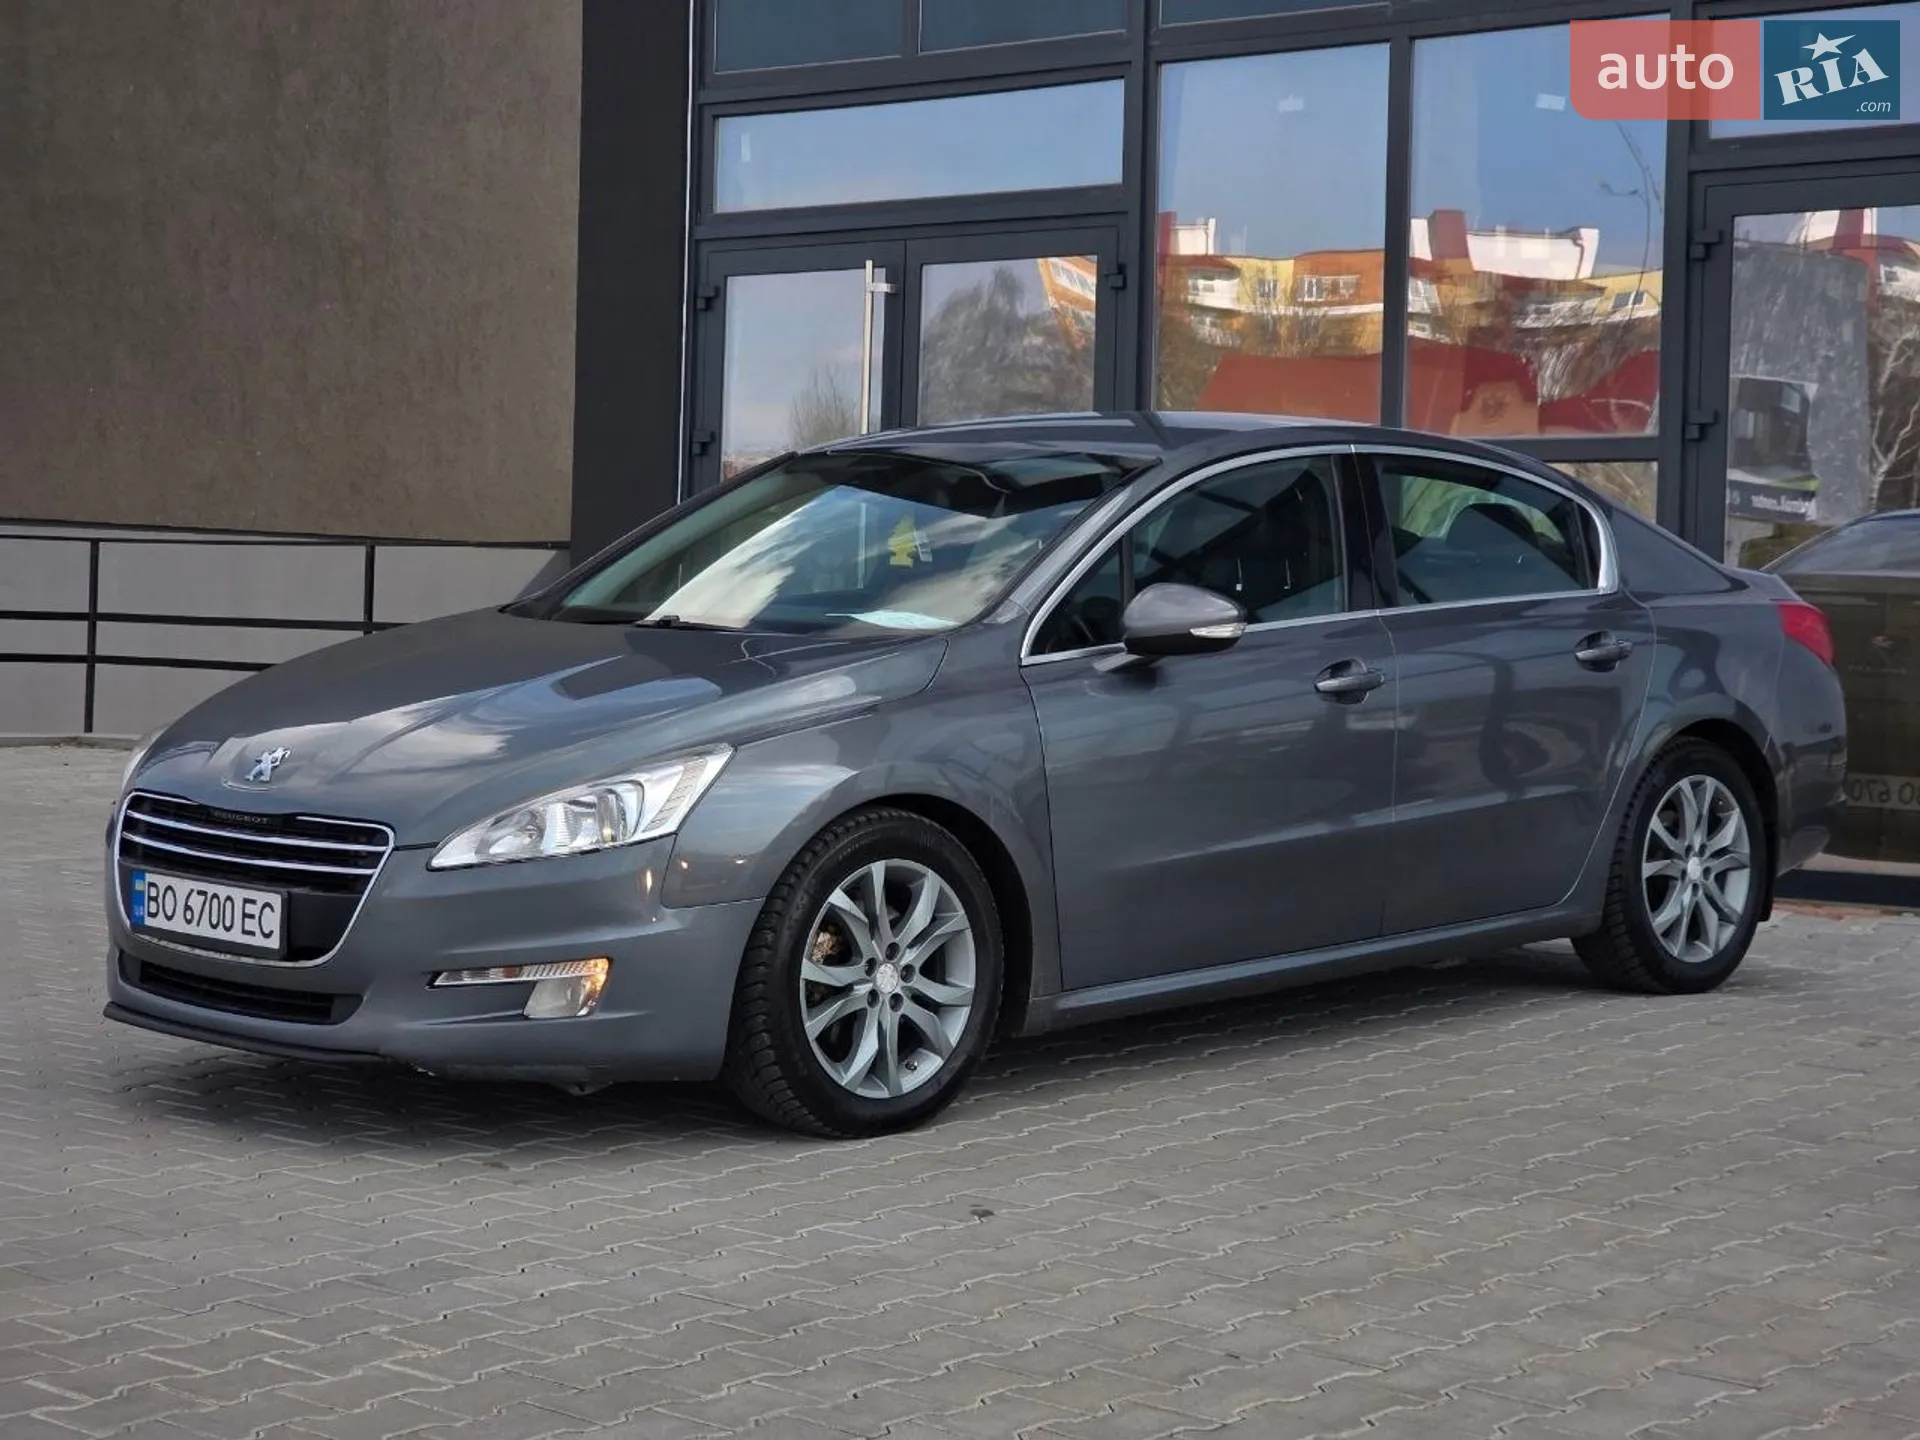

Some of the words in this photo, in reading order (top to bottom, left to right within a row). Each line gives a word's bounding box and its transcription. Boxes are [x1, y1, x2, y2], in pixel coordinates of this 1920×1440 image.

[147, 882, 177, 921] BO
[183, 887, 235, 932] 6700
[241, 898, 275, 939] EC
